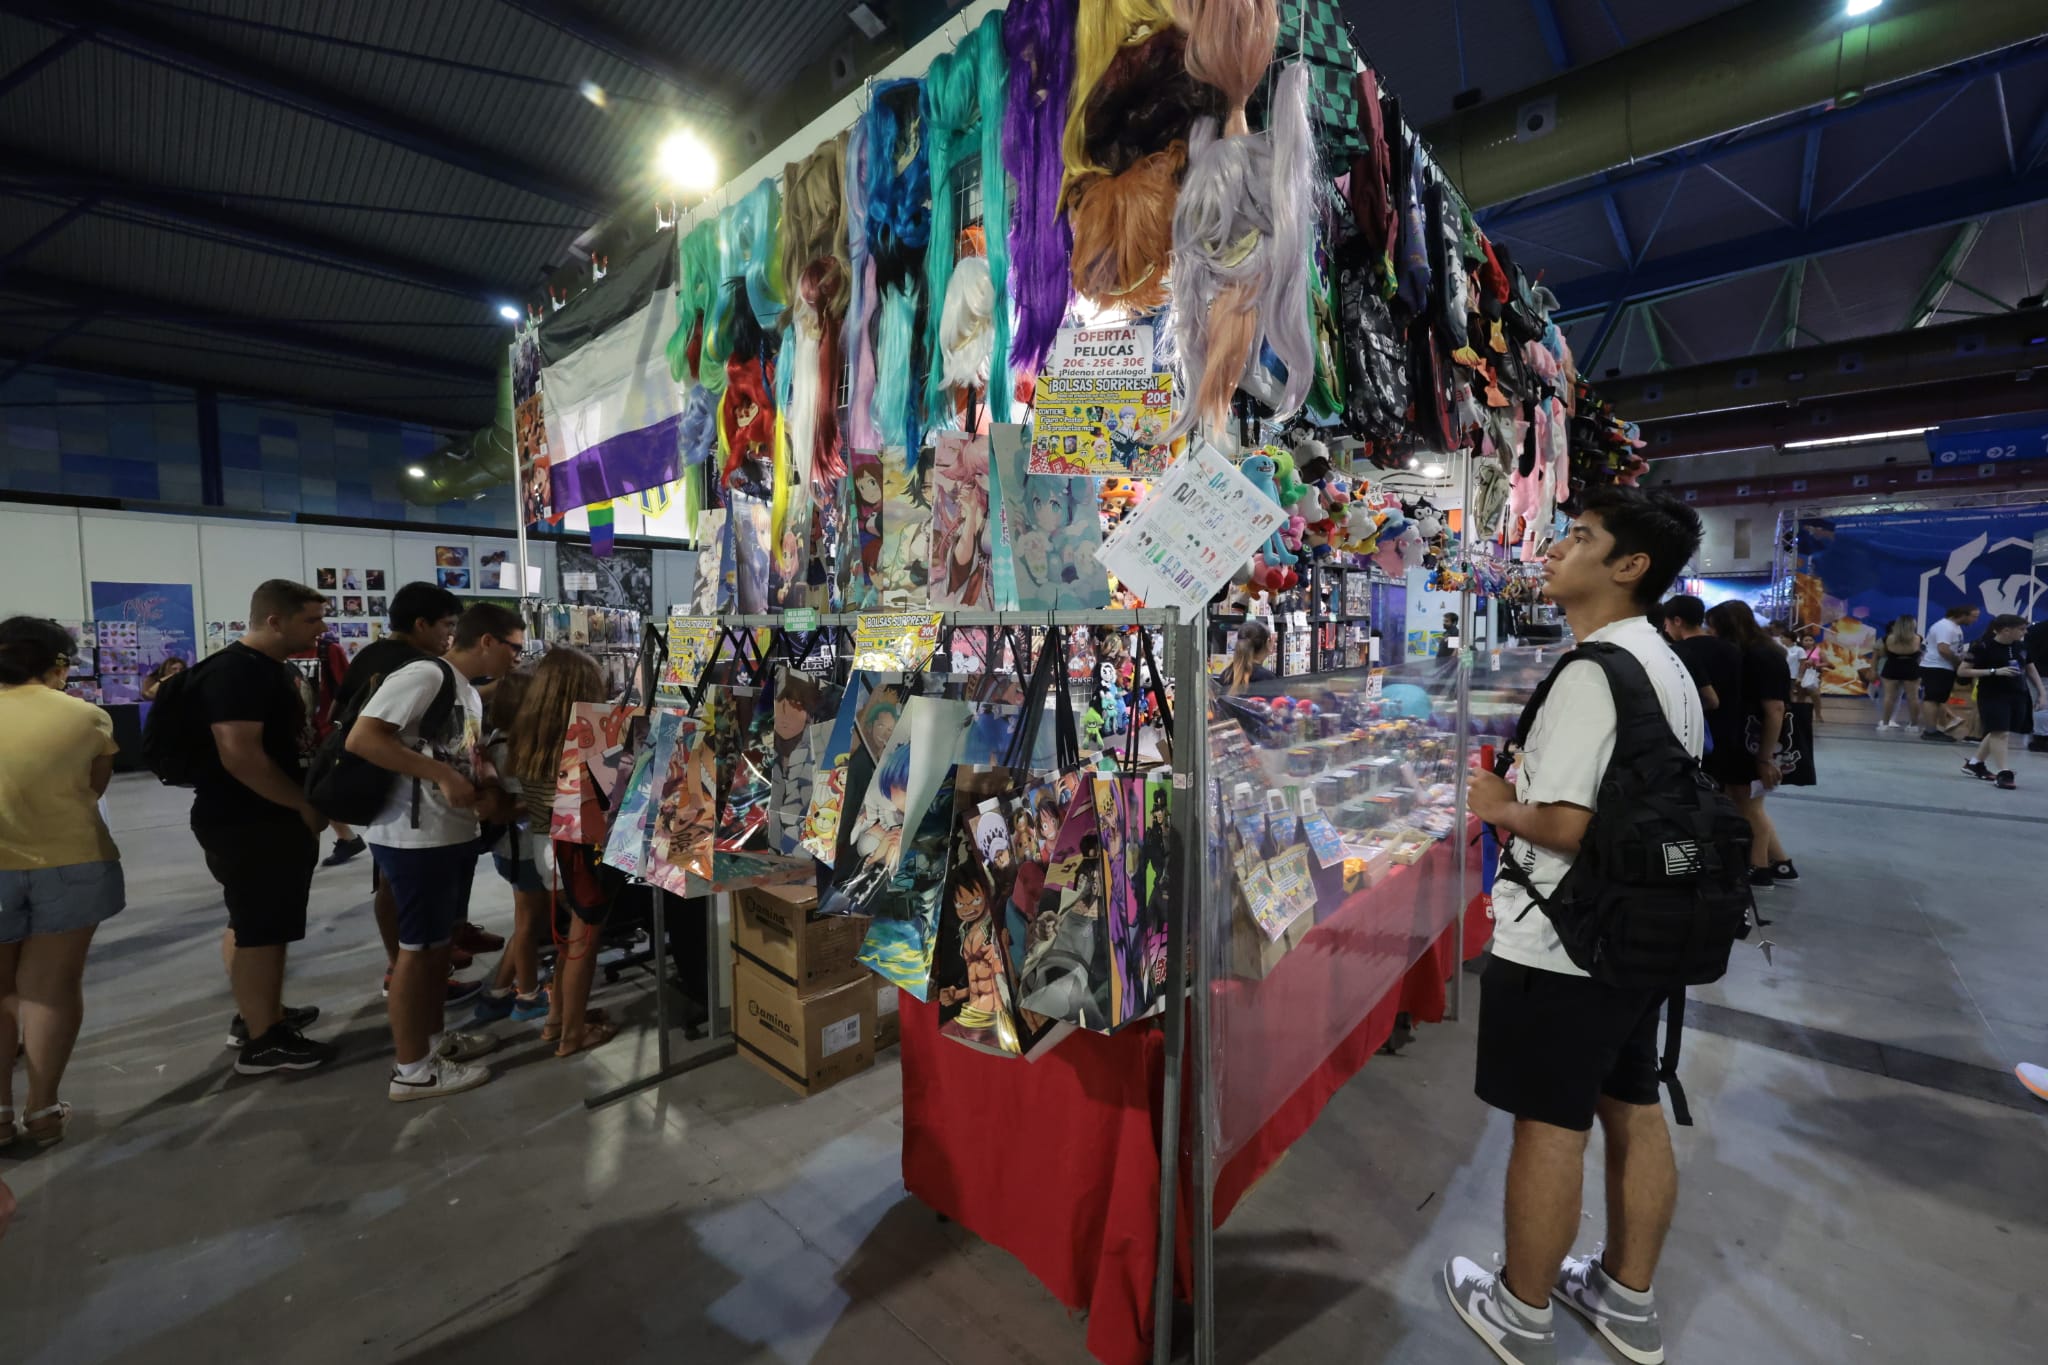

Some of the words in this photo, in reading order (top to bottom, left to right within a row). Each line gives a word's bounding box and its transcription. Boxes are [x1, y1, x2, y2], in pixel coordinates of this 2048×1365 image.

[1074, 329, 1136, 344] ¡OFERTA!
[1074, 345, 1134, 357] PELUCAS
[1063, 359, 1085, 368] 20€
[1093, 358, 1114, 368] 25€
[1122, 357, 1145, 367] 30€
[1059, 368, 1095, 377] ¡Pídenos
[1097, 368, 1105, 376] el
[1107, 368, 1147, 377] catálogo!
[1048, 378, 1094, 394] ¡BOLSAS
[1095, 376, 1160, 391] SORPRESA!
[1146, 392, 1168, 403] 20€
[2005, 445, 2017, 457] 2
